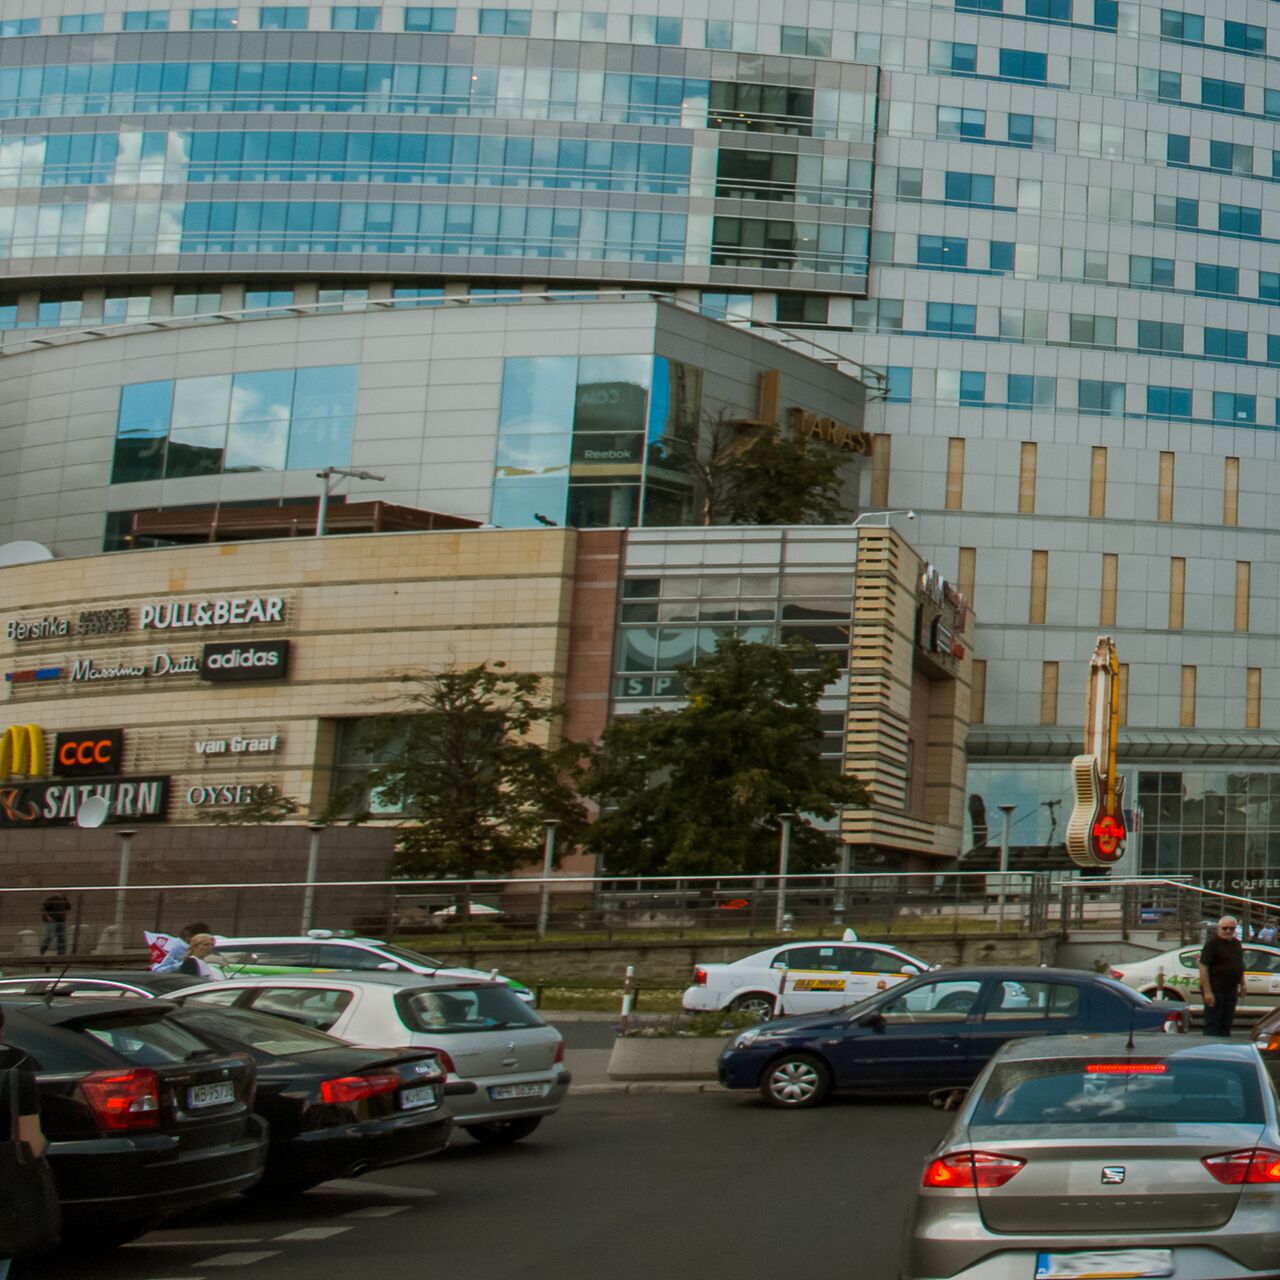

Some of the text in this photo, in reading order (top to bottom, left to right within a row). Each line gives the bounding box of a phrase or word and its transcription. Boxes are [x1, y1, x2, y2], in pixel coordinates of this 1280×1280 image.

[584, 449, 632, 459] Reebok
[140, 596, 283, 630] PULL&BEAR
[6, 617, 70, 640] Bershka
[70, 660, 147, 682] Massimo
[151, 653, 200, 677] Dutti
[208, 648, 279, 669] adidas
[59, 740, 112, 766] CCC
[195, 735, 279, 754] van Graaf
[1231, 878, 1280, 890] COFFEE
